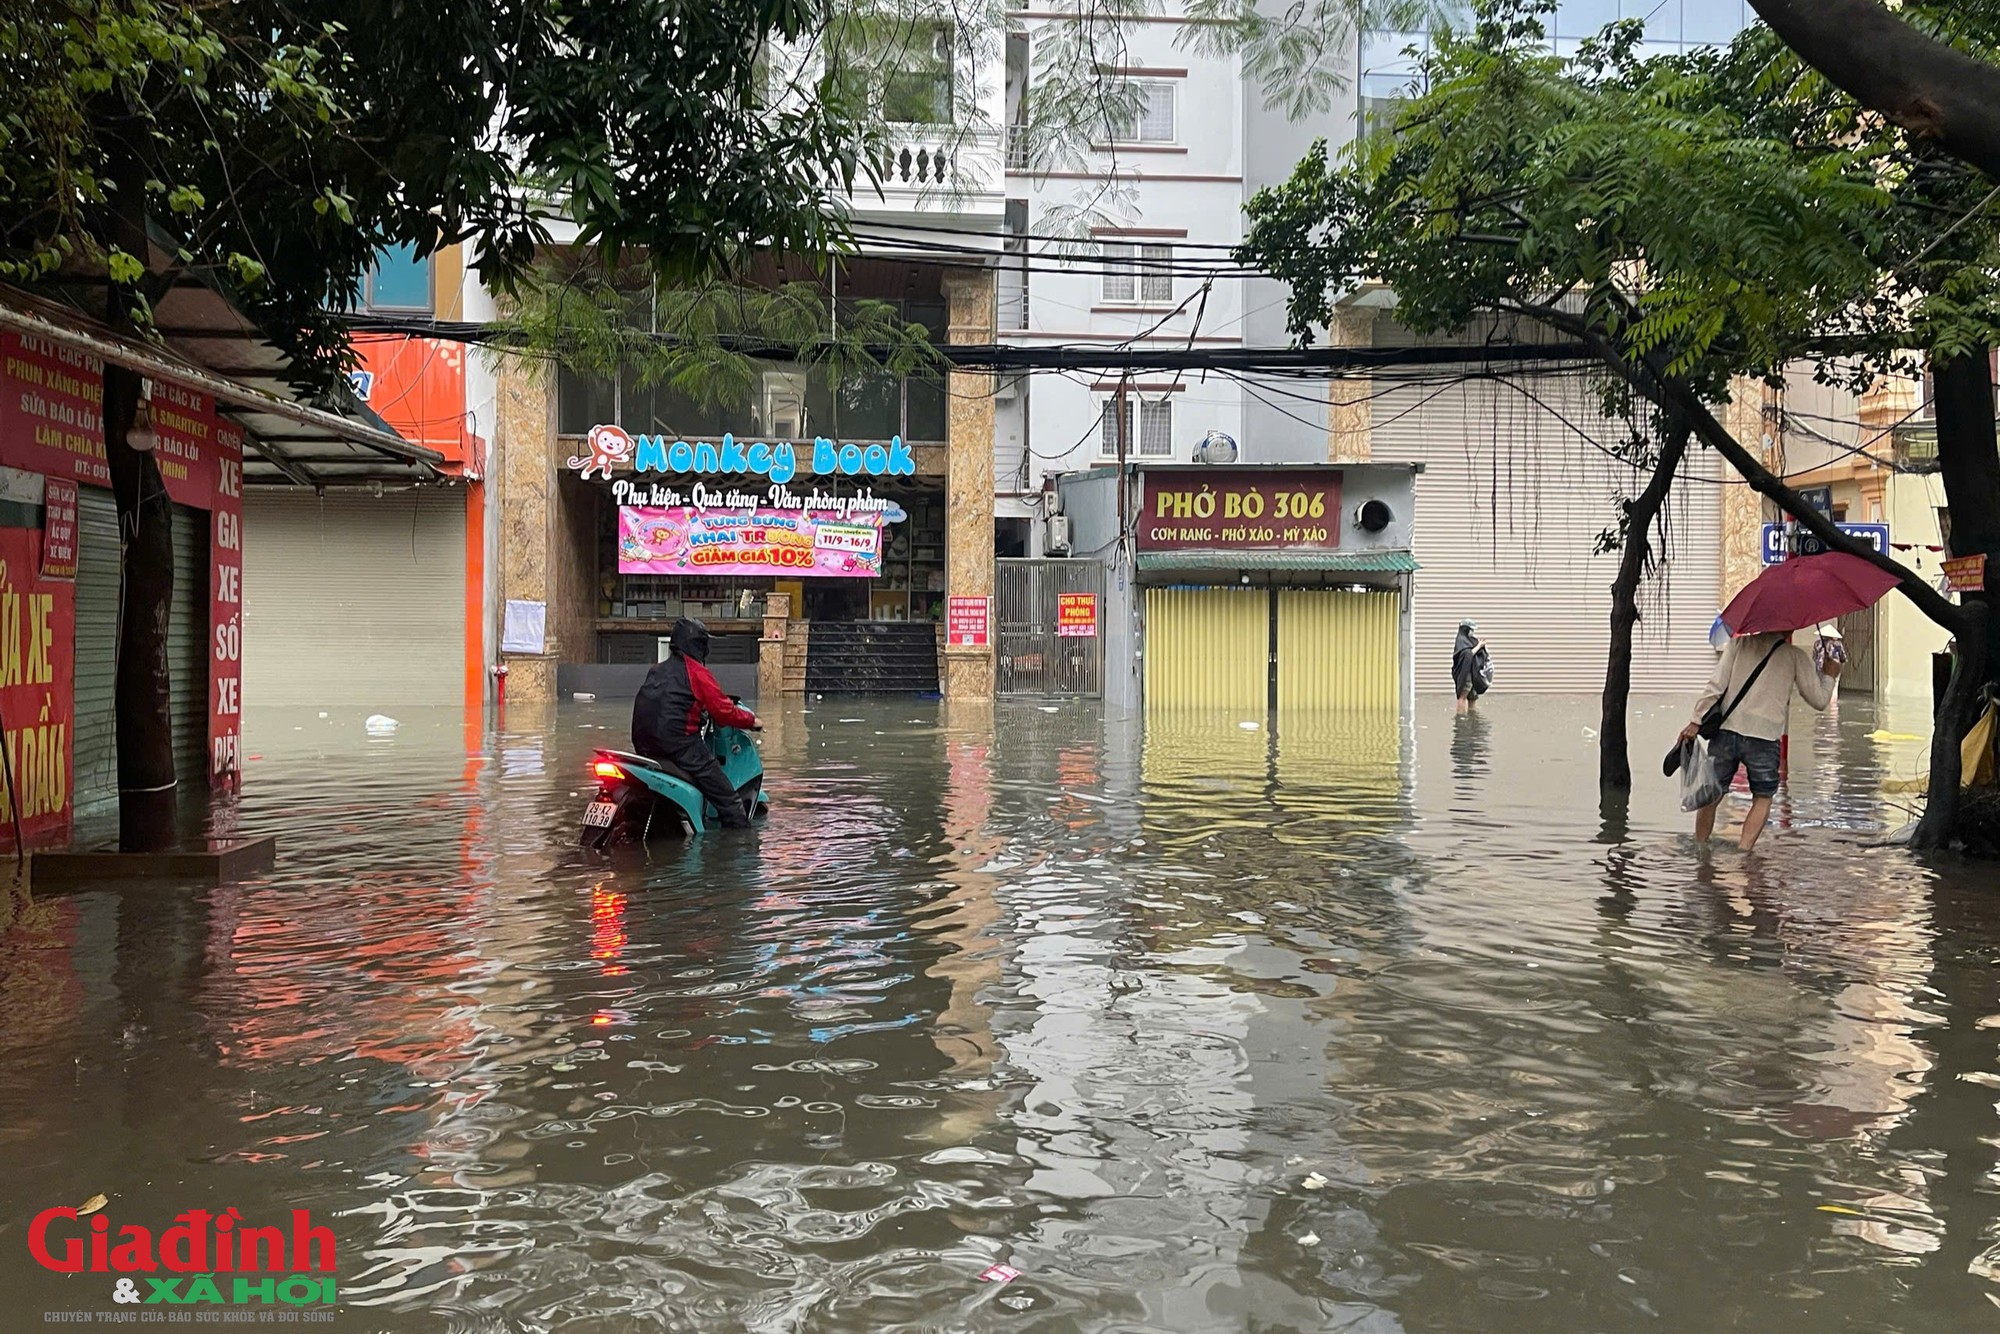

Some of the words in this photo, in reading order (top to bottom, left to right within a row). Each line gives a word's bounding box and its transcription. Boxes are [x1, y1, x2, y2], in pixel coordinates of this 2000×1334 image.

[7, 357, 43, 385] PHUN
[46, 368, 79, 396] XĂNG
[159, 410, 208, 439] SMARTKEY
[190, 394, 202, 412] XE
[20, 390, 46, 417] SỬA
[50, 400, 74, 424] BÁO
[77, 407, 95, 431] LỖI
[163, 436, 182, 456] BÁO
[35, 423, 62, 449] LÀM
[65, 432, 93, 455] CHÌA
[217, 429, 241, 453] CHUYÊN
[162, 459, 188, 481] MINH
[218, 456, 240, 498] XE
[634, 432, 796, 484] Monkey
[812, 434, 916, 476] Book
[612, 480, 649, 509] Phụ
[650, 486, 682, 511] kiện
[692, 482, 723, 515] Quà
[724, 488, 759, 517] tặng
[768, 484, 802, 510] Văn
[803, 488, 847, 520] phòng
[847, 487, 888, 520] phẩm
[1156, 483, 1217, 519] PHỞ
[1223, 486, 1265, 519] BÒ
[1273, 491, 1326, 519] 306
[217, 510, 240, 551] GA
[689, 530, 737, 546] KHAI
[740, 529, 814, 548] TRƯƠNG
[823, 535, 843, 545] 11/9
[850, 538, 871, 548] 16/9
[1150, 526, 1177, 541] CƠM
[1180, 528, 1212, 541] RANG
[1221, 524, 1246, 541] PHỞ
[1249, 525, 1274, 541] XÀO
[1283, 525, 1300, 541] MỲ
[1302, 524, 1327, 541] XÀO
[692, 547, 735, 563] GIẢM
[739, 548, 767, 563] GIÁ
[769, 548, 814, 566] 10%
[217, 564, 240, 604] XE
[1060, 597, 1076, 606] CHO
[26, 592, 53, 685] XE
[215, 612, 240, 662] SỐ
[216, 677, 240, 715] XE
[22, 692, 66, 820] DẦU
